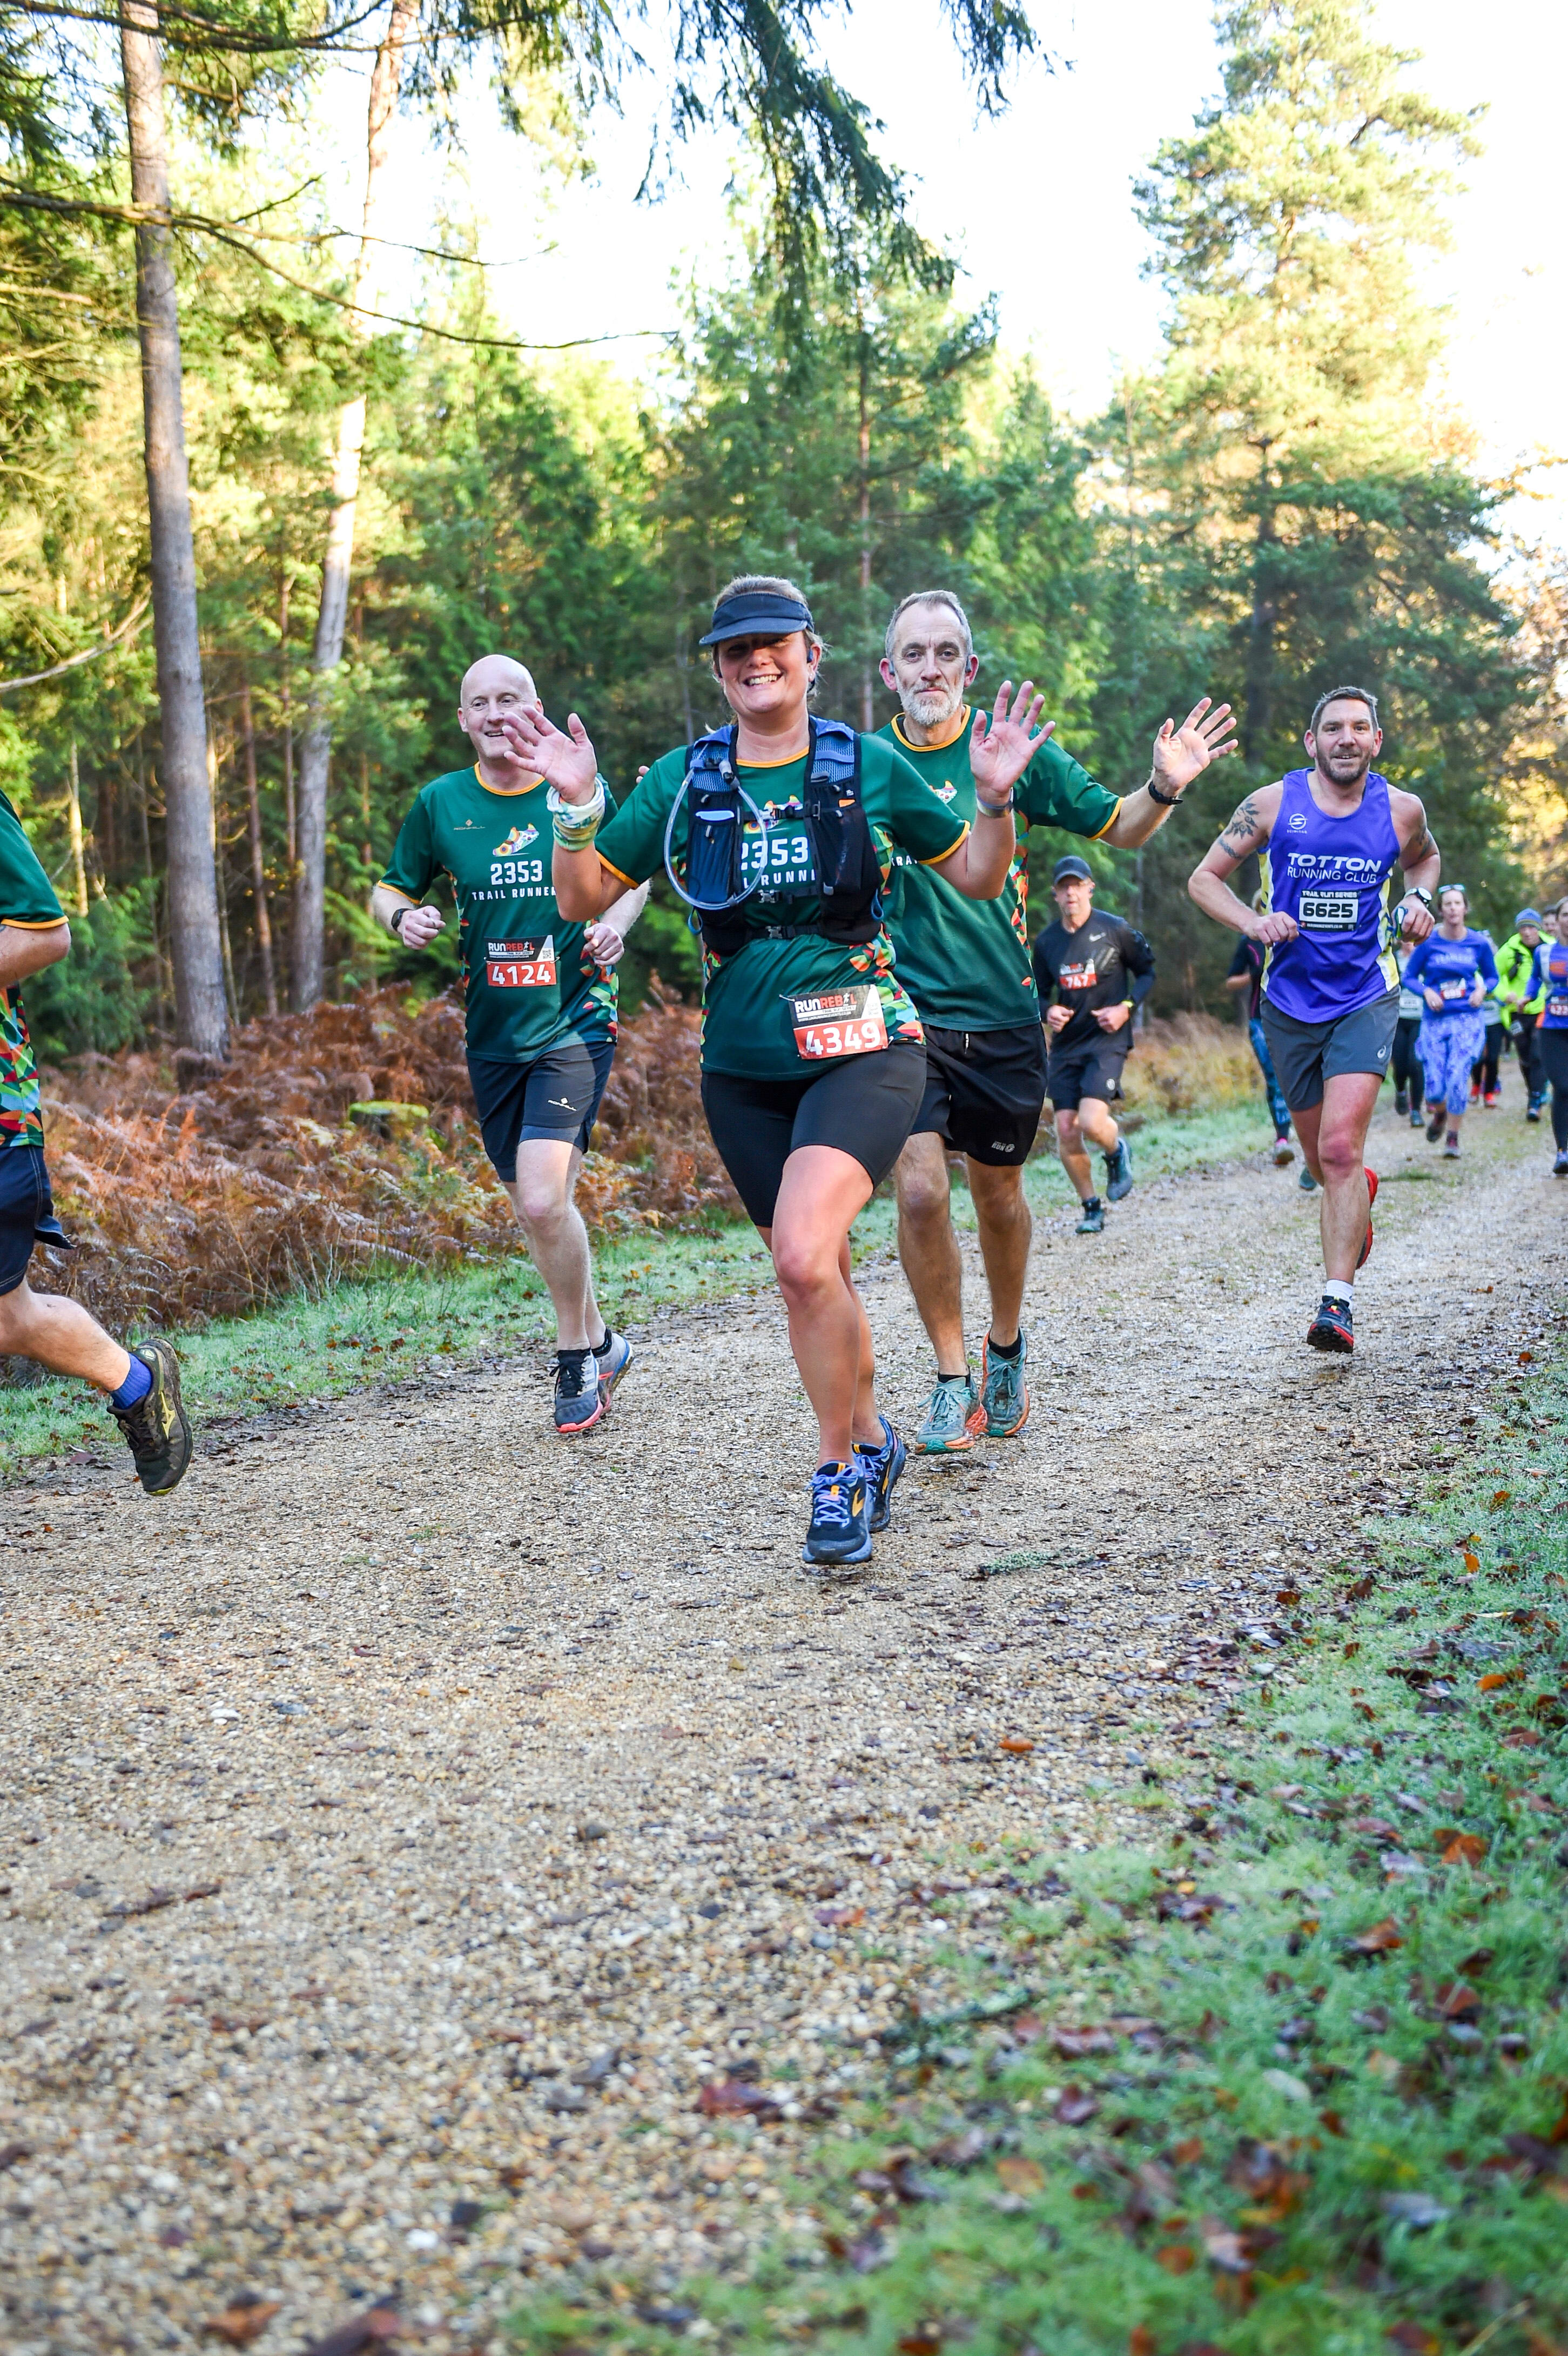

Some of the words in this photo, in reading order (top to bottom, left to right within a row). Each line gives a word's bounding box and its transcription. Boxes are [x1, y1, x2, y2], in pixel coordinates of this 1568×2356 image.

[490, 860, 542, 885] 2353
[1288, 852, 1382, 873] TOTTON
[1288, 866, 1341, 881] RUNNING
[1345, 872, 1377, 884] CLUB
[472, 890, 506, 900] TRAIL
[1303, 903, 1354, 918] 6625
[492, 964, 551, 985] 4124
[806, 1022, 880, 1055] 4349
